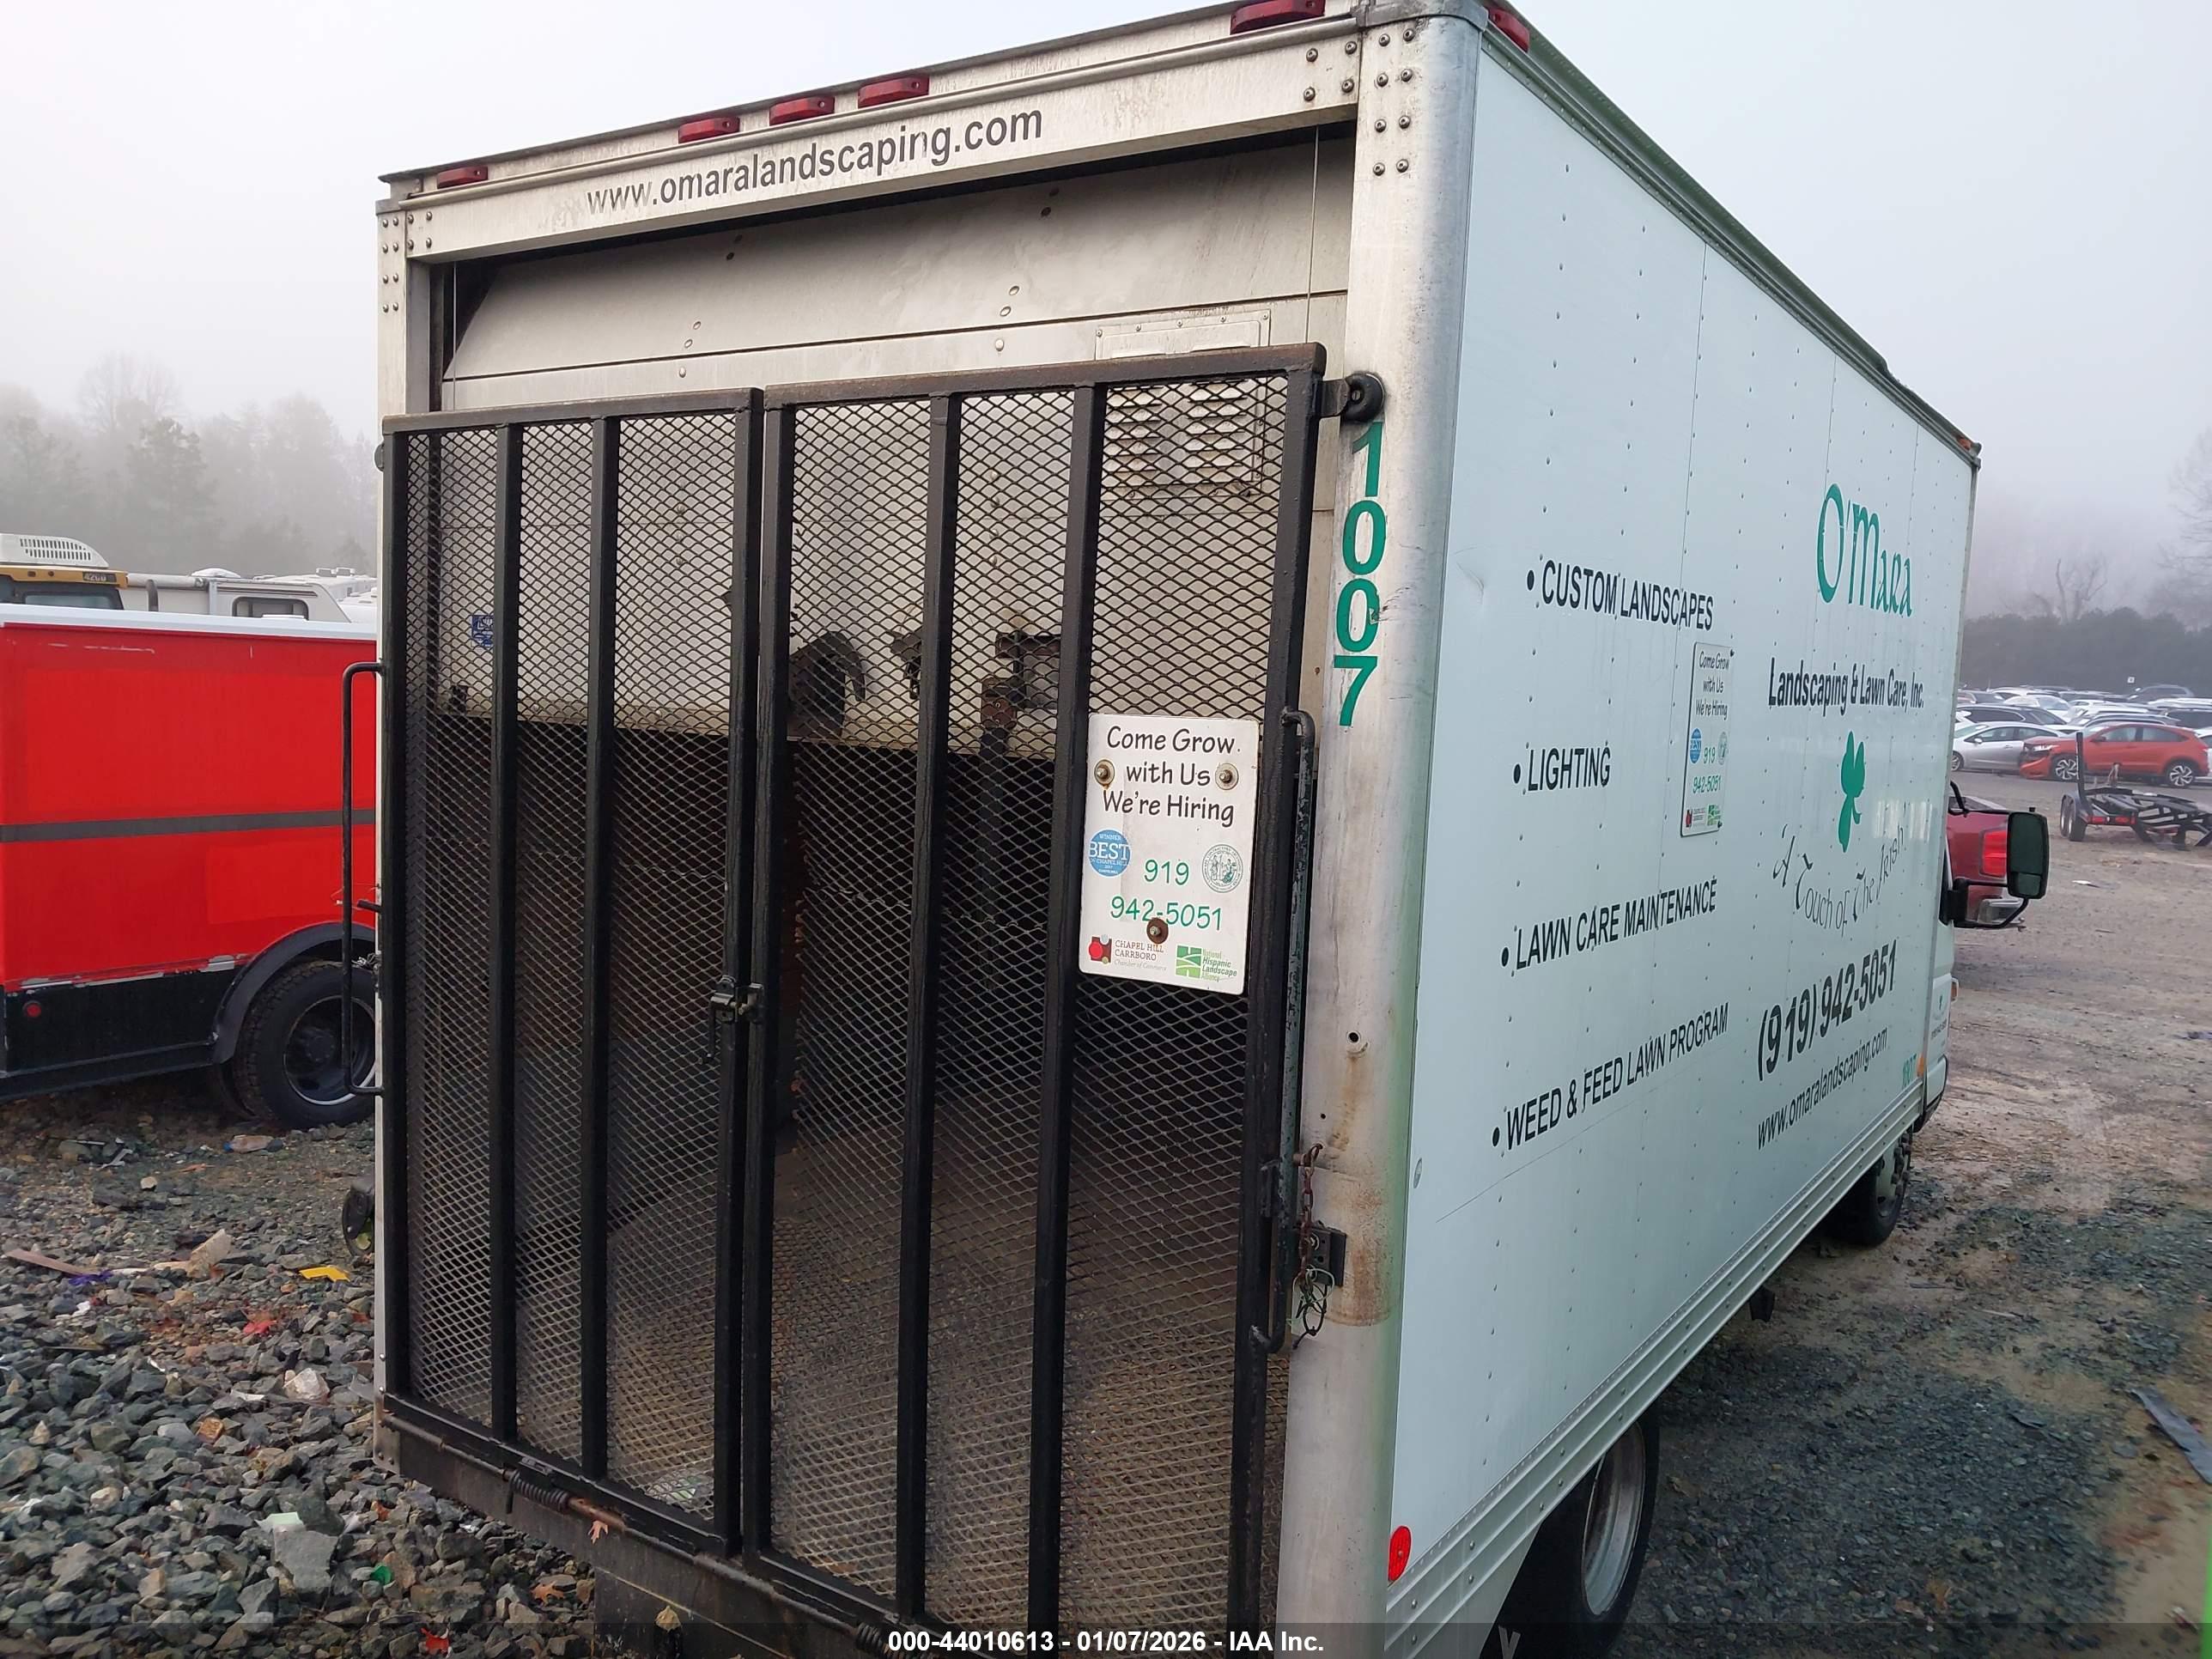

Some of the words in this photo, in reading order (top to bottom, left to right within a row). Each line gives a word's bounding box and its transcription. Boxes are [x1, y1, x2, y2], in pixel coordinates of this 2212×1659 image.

[586, 108, 1042, 216] www.omaralandscaping.com
[1334, 422, 1387, 726] 1007
[1542, 559, 1618, 616] CUSTOM
[1620, 578, 1714, 631] LANDSCAPES
[1699, 651, 1715, 669] Come
[1769, 657, 1847, 717] Landscaping
[1850, 663, 1858, 704] &
[1860, 665, 1886, 705] Lawn
[1888, 668, 1907, 713] Care,
[1910, 672, 1924, 708] Inc.
[1107, 726, 1166, 751] Come
[1704, 746, 1716, 764] 919
[1127, 761, 1173, 784] with
[1181, 763, 1211, 787] Us
[1528, 745, 1611, 792] LIGHTING
[1103, 790, 1161, 815] We're
[1167, 794, 1235, 828] Hiring
[1089, 842, 1130, 860] BEST
[1144, 860, 1190, 885] 919
[1110, 896, 1222, 931] 942-5051
[1516, 916, 1571, 969] LAWN
[1577, 904, 1621, 952] CARE
[1624, 879, 1717, 939] MAINTENANCE
[1836, 890, 1850, 938] of
[1115, 940, 1145, 951] CHAPEL
[1147, 944, 1164, 952] HILL
[1115, 949, 1157, 961] CARRBORO
[1202, 957, 1231, 968] Hispanic
[1202, 965, 1237, 977] Landscape
[1758, 983, 1817, 1082] (919)
[1820, 939, 1898, 1038] 942-5051
[1507, 1087, 1562, 1150] WEED
[1567, 1079, 1577, 1119] &
[1583, 1057, 1623, 1109] FEED
[1627, 1033, 1666, 1086] LAWN
[1669, 1002, 1729, 1063] PROGRAM
[1757, 1027, 1887, 1151] www.omaralandscaping.com
